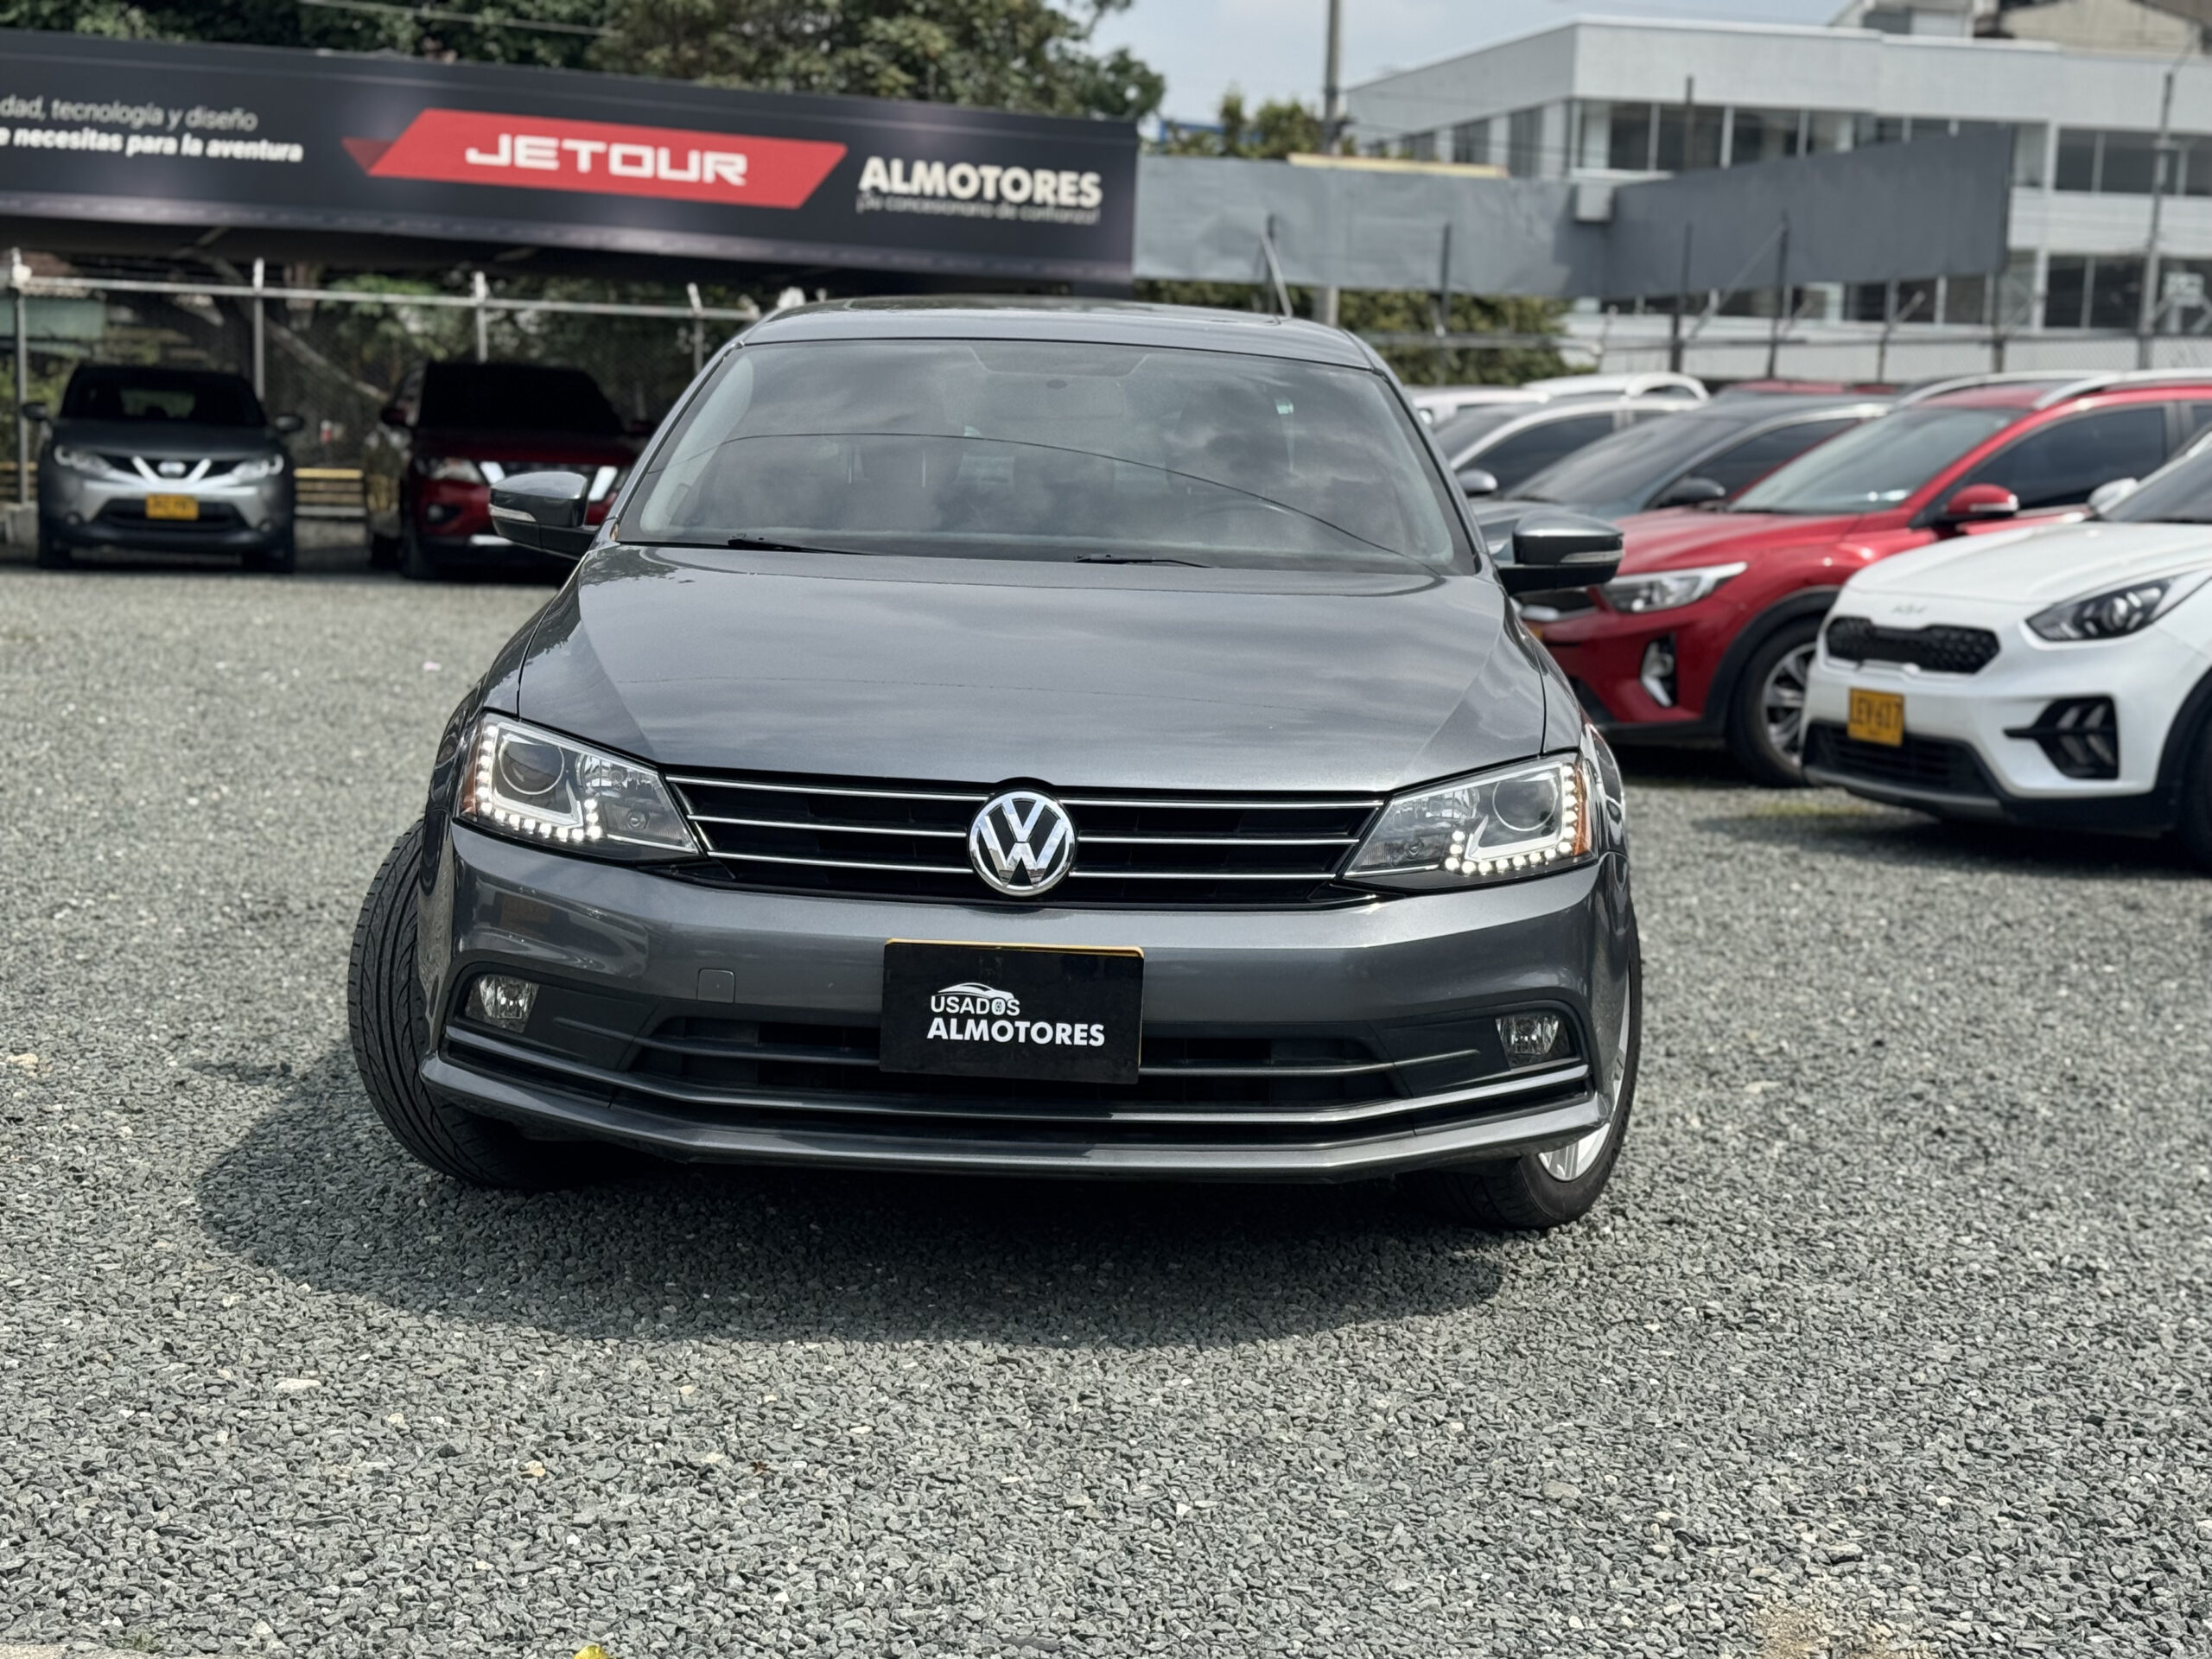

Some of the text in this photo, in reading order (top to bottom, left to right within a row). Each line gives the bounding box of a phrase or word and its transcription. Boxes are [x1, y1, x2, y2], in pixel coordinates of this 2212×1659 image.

[51, 99, 164, 130] tecnología
[168, 109, 183, 132] y
[185, 105, 258, 131] diseño
[13, 127, 123, 152] necesitas
[125, 134, 178, 157] para
[181, 133, 203, 156] la
[206, 140, 303, 162] aventura
[465, 133, 748, 187] JETOUR
[858, 156, 1103, 208] ALMOTORES
[931, 995, 1020, 1016] USADOS
[926, 1017, 1105, 1047] ALMOTORES
